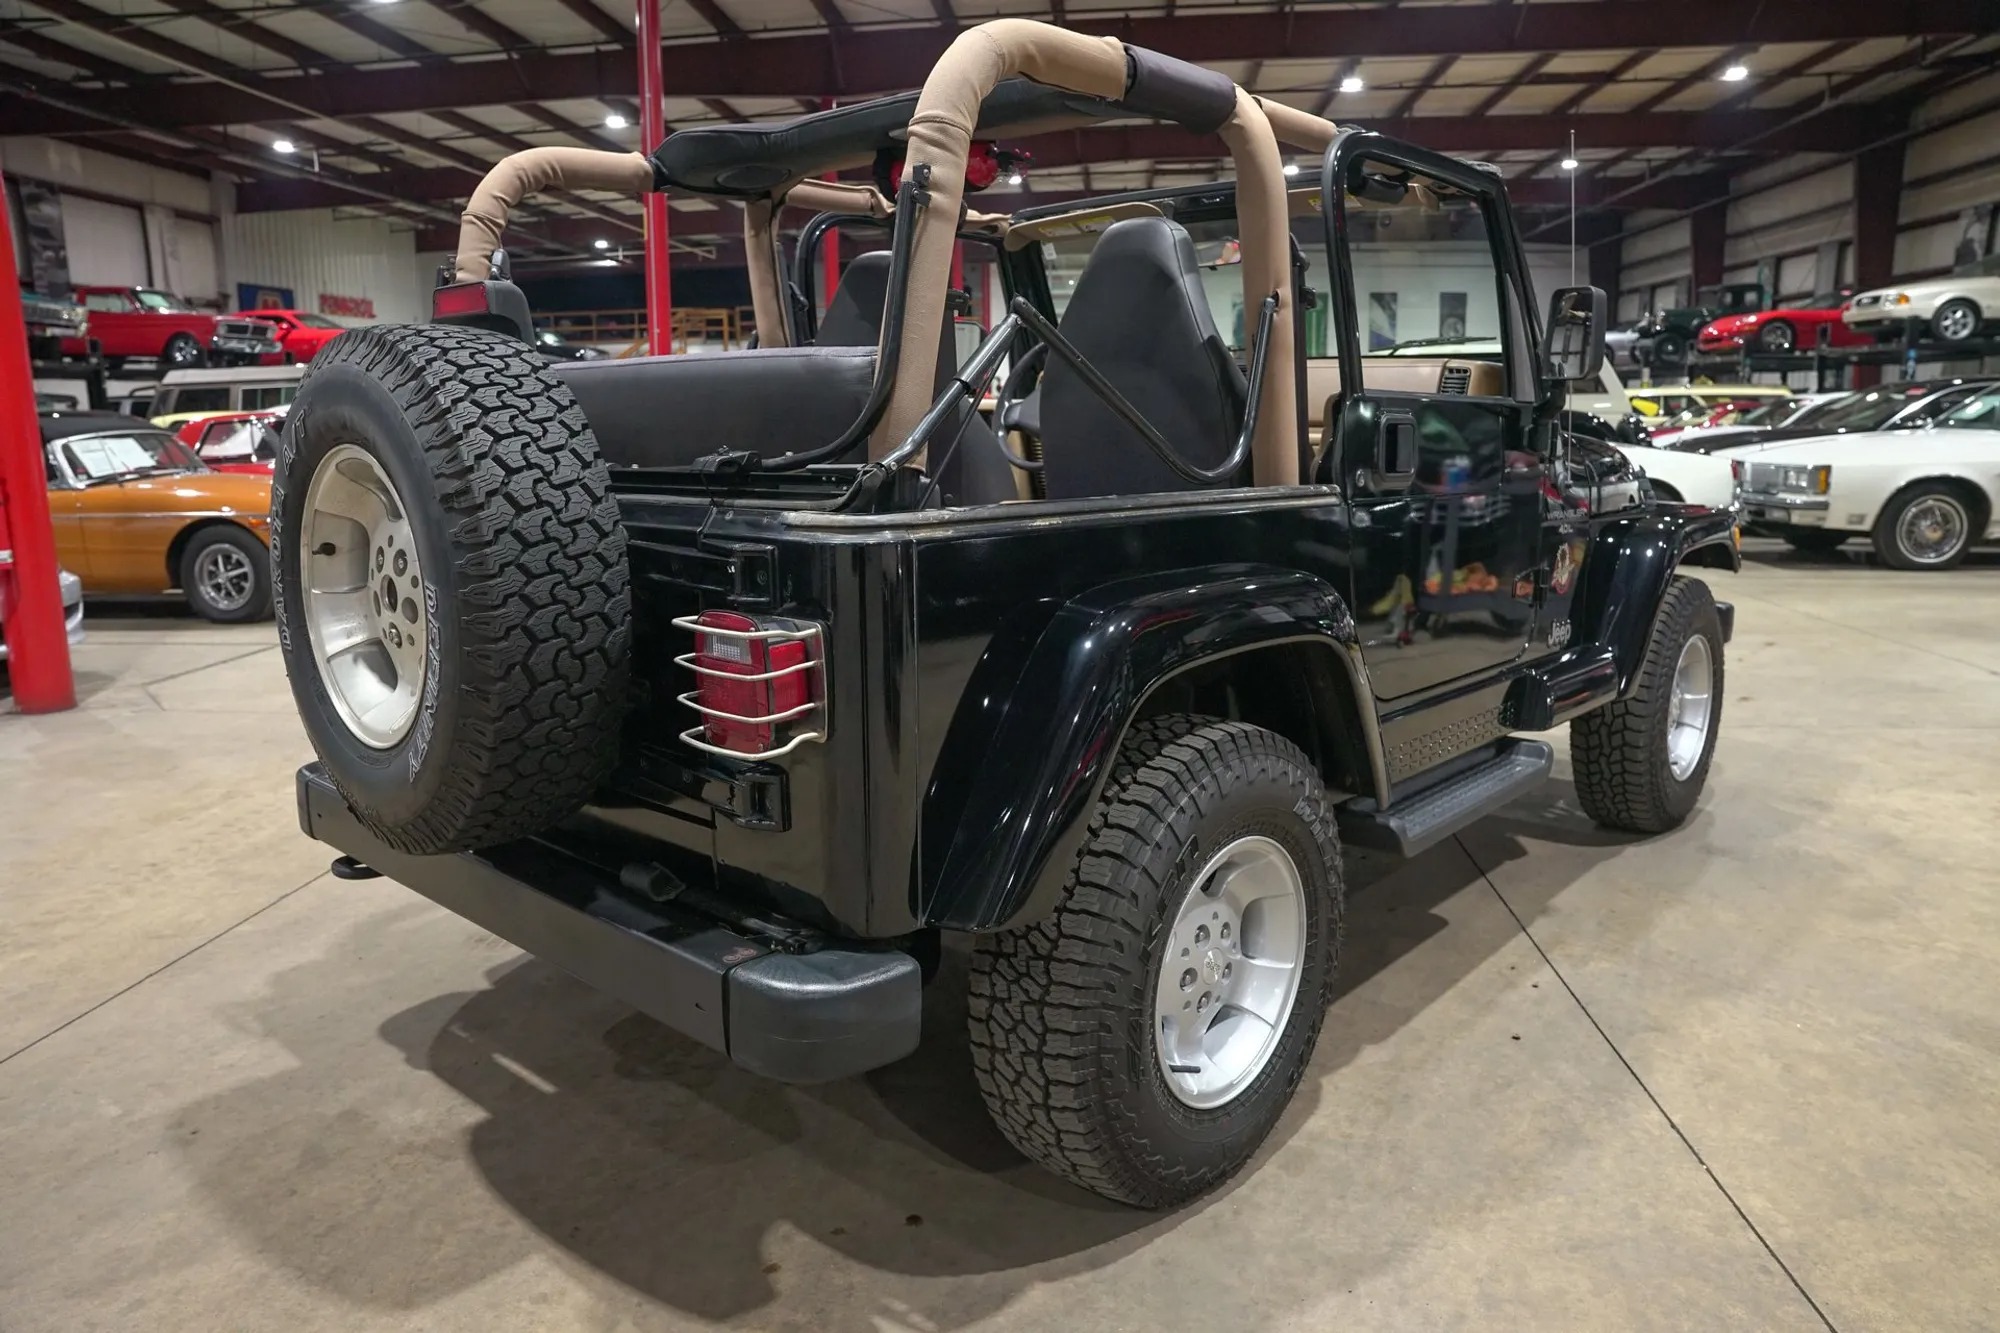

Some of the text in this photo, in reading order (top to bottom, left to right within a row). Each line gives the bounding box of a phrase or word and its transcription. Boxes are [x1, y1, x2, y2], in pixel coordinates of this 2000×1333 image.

[271, 484, 292, 651] DAKOTA
[1547, 619, 1571, 648] Jeep
[408, 584, 440, 784] DEFINITY
